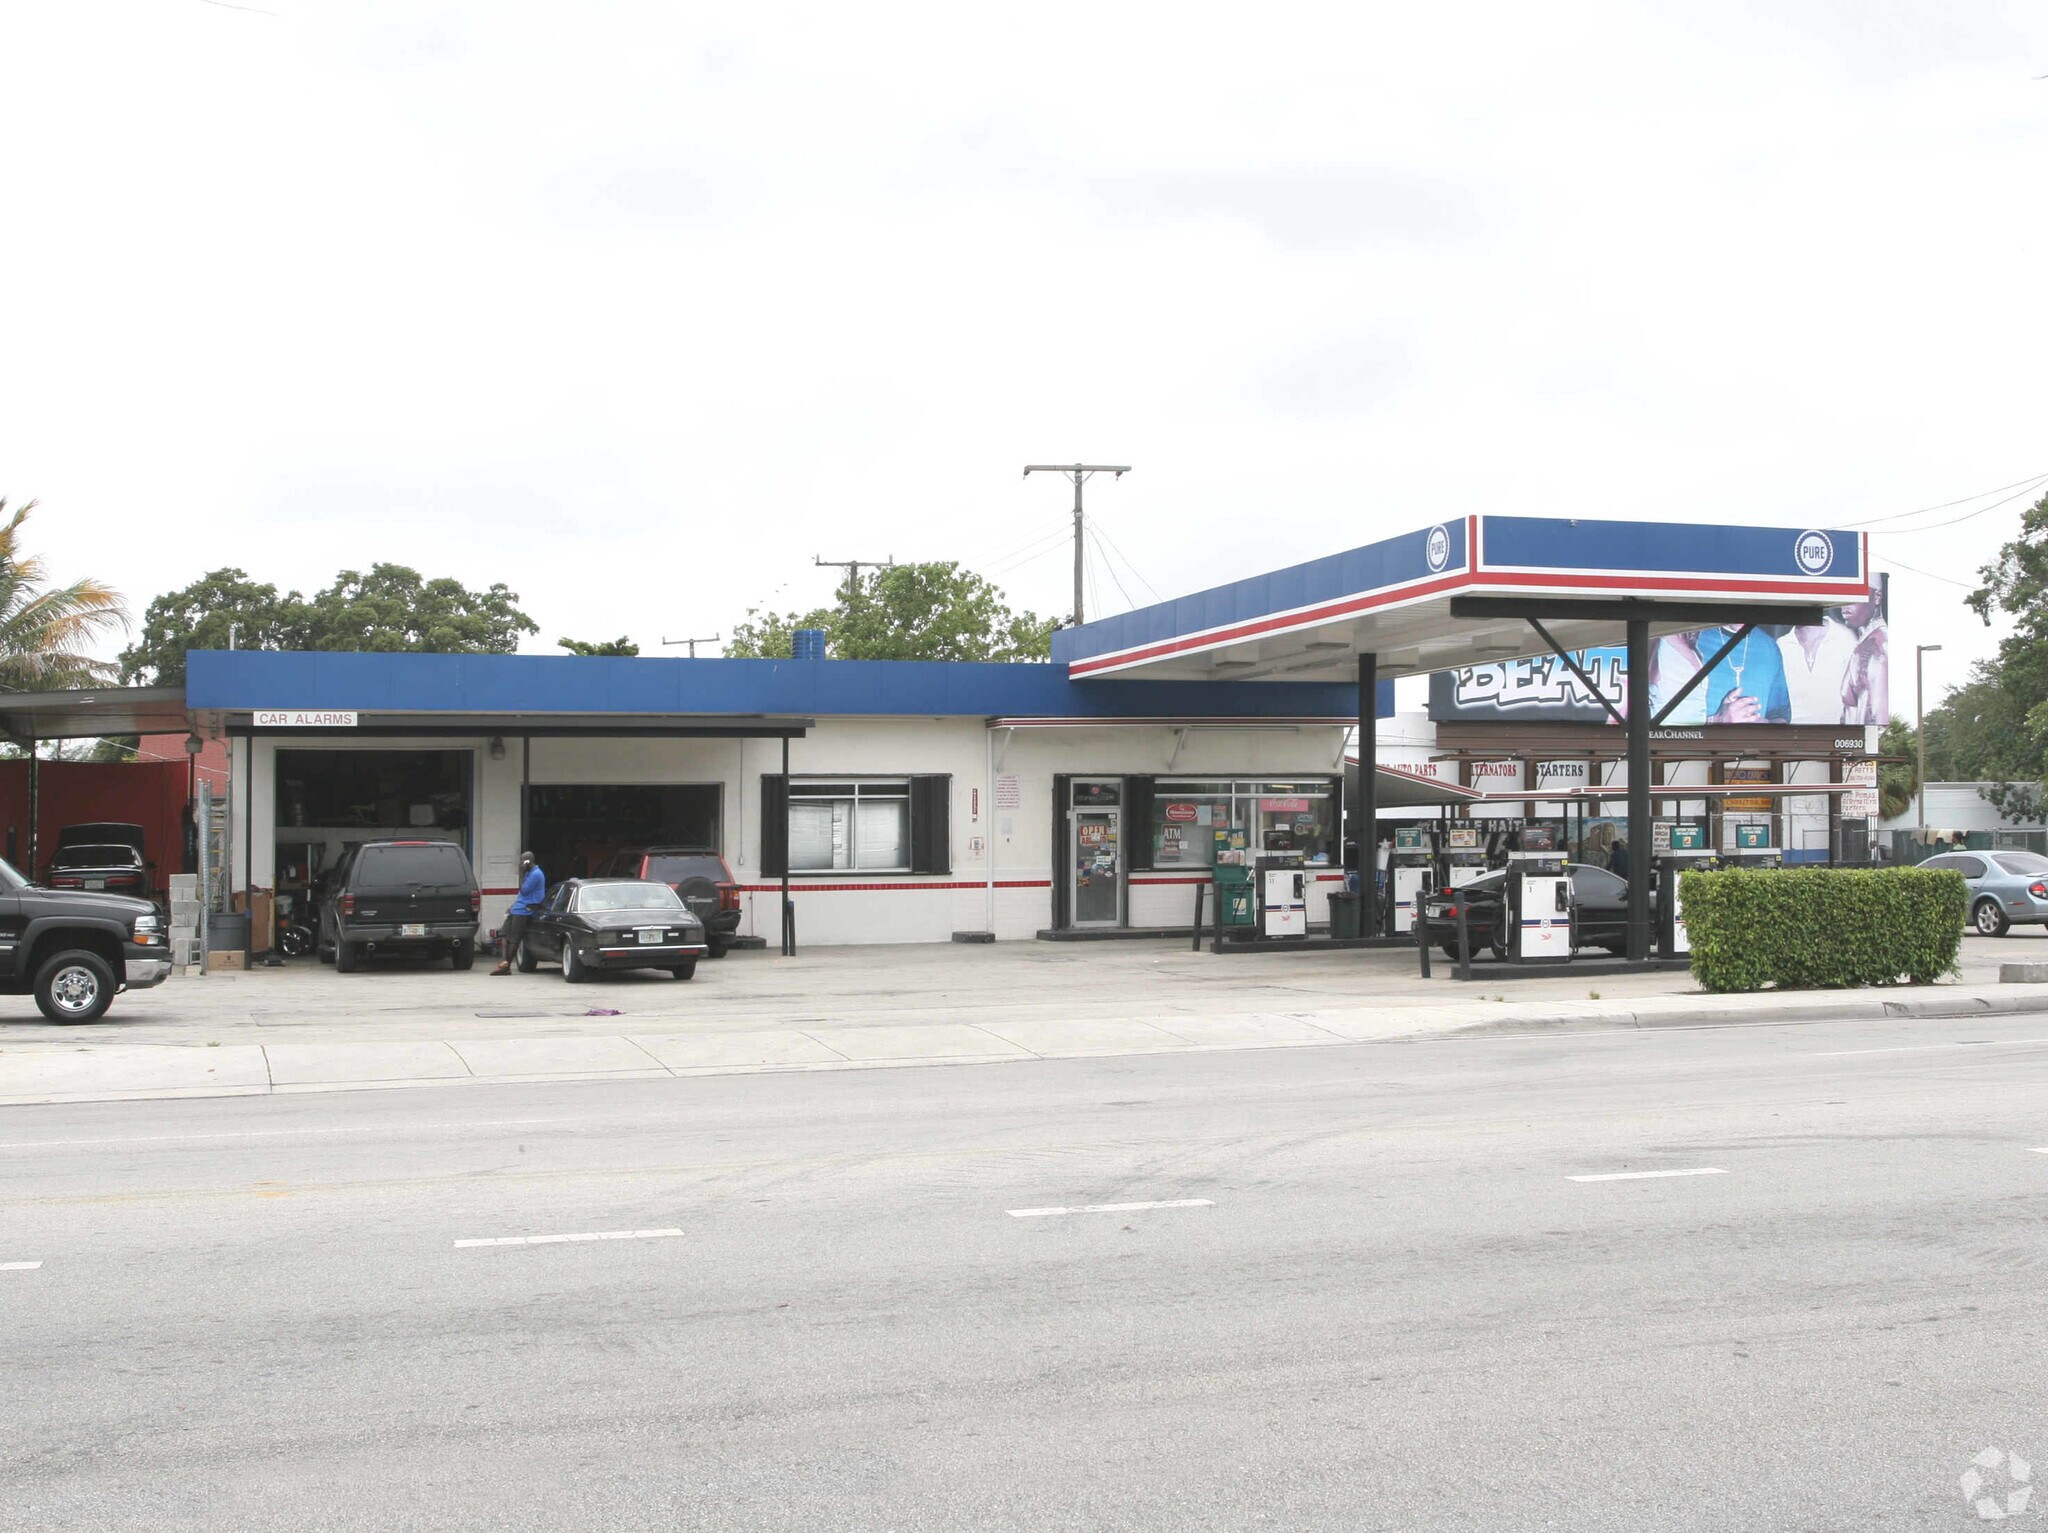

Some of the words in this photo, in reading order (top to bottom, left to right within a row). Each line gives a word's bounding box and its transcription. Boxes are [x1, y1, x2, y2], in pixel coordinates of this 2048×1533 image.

[1803, 545, 1825, 559] PURE
[1455, 647, 1628, 706] BEAT
[260, 713, 288, 725] CAR
[295, 713, 353, 725] ALARMS
[1834, 739, 1864, 749] 006930
[1415, 763, 1437, 776] PARTS
[1471, 764, 1517, 777] LTERNATORS
[1535, 764, 1584, 777] STARTERS
[1082, 826, 1105, 836] OPEN
[1433, 819, 1482, 833] LTTLE
[1163, 828, 1181, 840] ATM
